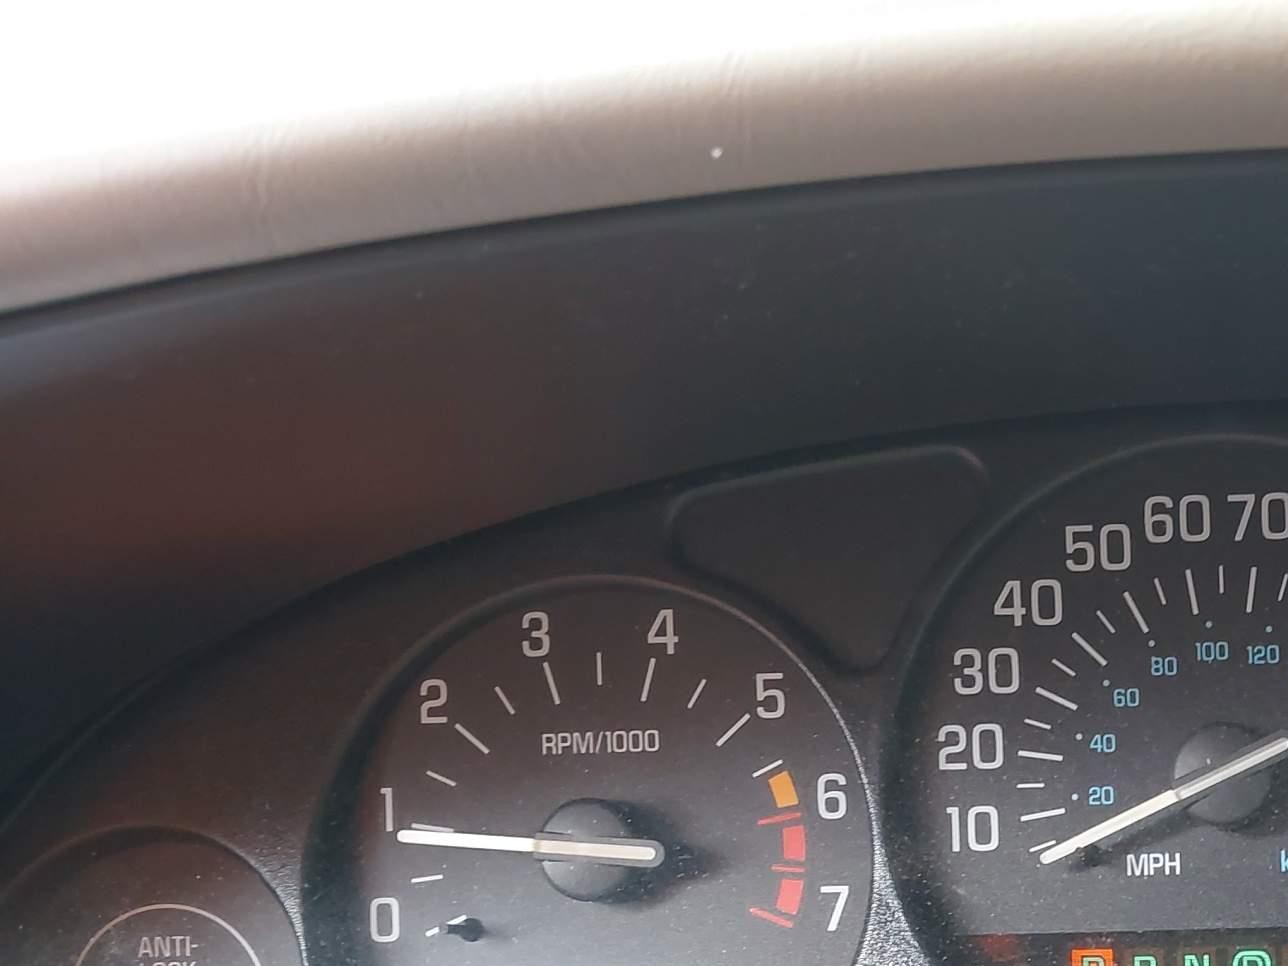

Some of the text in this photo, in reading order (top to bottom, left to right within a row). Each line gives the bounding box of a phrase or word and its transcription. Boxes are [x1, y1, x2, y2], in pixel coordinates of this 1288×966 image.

[1144, 494, 1211, 543] 60
[1065, 524, 1132, 571] 50
[994, 579, 1062, 627] 40
[521, 612, 550, 657] 3
[647, 609, 679, 655] 4
[1195, 641, 1229, 662] 100
[1246, 644, 1280, 665] 120
[953, 647, 1019, 695] 30
[1150, 656, 1178, 677] 80
[420, 678, 448, 725] 2
[756, 673, 784, 719] 5
[1112, 687, 1140, 709] 60
[541, 729, 660, 757] RPM/1000
[937, 723, 1003, 770] 20
[1089, 733, 1116, 754] 40
[380, 787, 395, 832] 1
[815, 773, 847, 820] 6
[1088, 785, 1114, 807] 20
[946, 805, 1000, 853] 10
[1126, 853, 1181, 877] MPH
[369, 897, 400, 942] 0
[820, 885, 849, 931] 7
[138, 936, 199, 957] ANTI-
